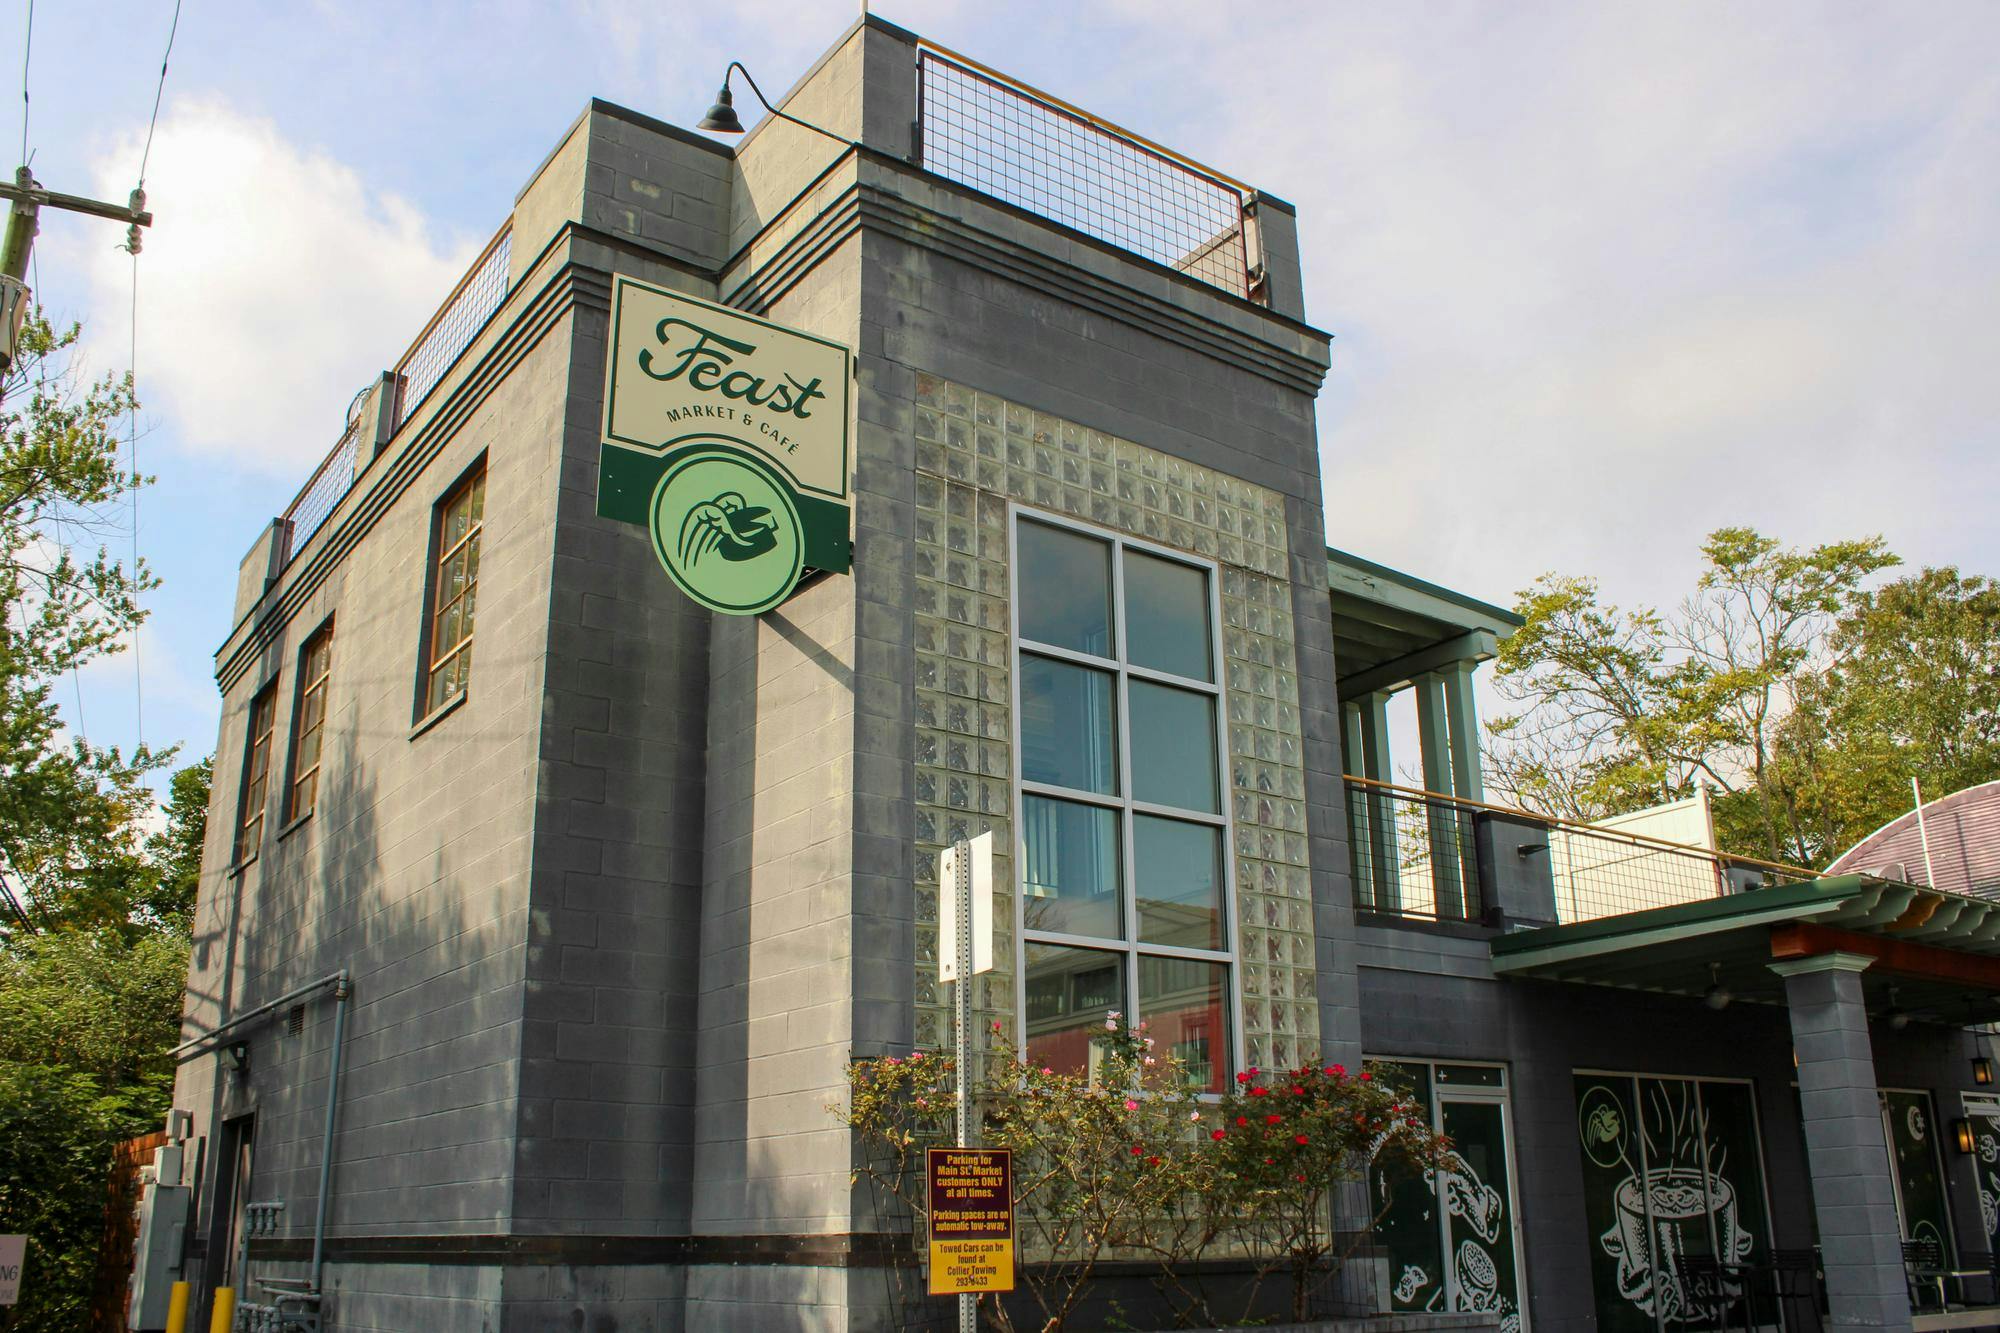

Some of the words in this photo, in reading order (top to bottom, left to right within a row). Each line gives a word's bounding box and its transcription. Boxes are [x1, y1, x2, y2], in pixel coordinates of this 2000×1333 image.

[638, 316, 826, 420] Feast
[666, 404, 737, 424] MARKET
[742, 413, 753, 427] &
[760, 421, 801, 457] CAFÉ
[947, 1155, 979, 1165] Parking
[981, 1155, 993, 1165] for
[937, 1165, 958, 1176] Main
[959, 1165, 971, 1176] St.
[972, 1165, 1003, 1176] Market
[936, 1177, 980, 1187] customers
[981, 1176, 1003, 1187] ONLY
[946, 1188, 955, 1198] at
[956, 1187, 967, 1198] all
[969, 1187, 995, 1198] times.
[933, 1210, 960, 1221] Parking
[961, 1211, 986, 1220] spaces
[987, 1210, 999, 1220] are
[999, 1210, 1009, 1219] on
[935, 1221, 970, 1232] automatic
[970, 1221, 1007, 1231] tow-away.
[939, 1244, 962, 1254] Towed
[963, 1243, 980, 1253] Cars
[980, 1244, 994, 1253] can
[995, 1243, 1004, 1252] be
[957, 1254, 977, 1264] found
[978, 1254, 986, 1264] at
[947, 1265, 970, 1276] Collier
[971, 1265, 997, 1276] Towing
